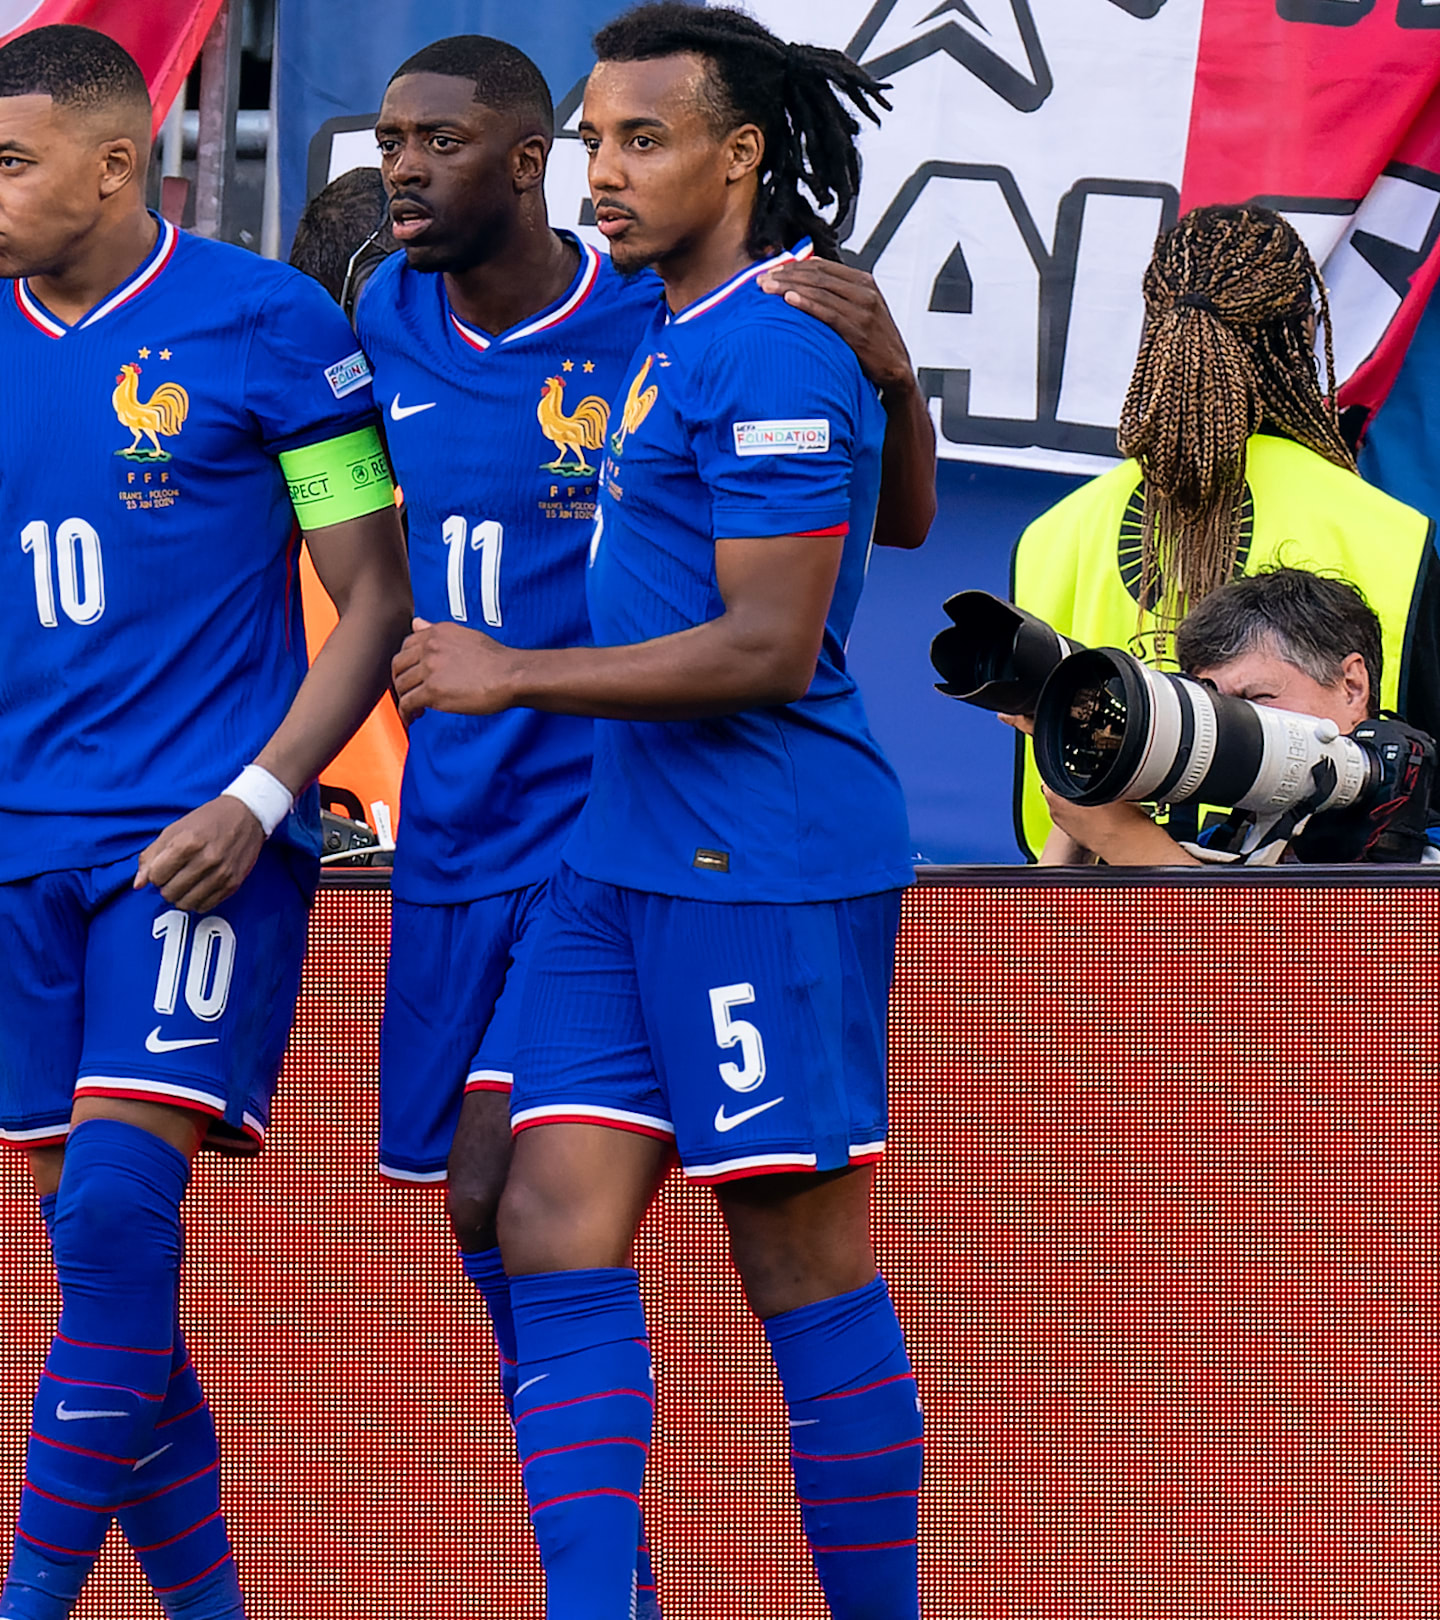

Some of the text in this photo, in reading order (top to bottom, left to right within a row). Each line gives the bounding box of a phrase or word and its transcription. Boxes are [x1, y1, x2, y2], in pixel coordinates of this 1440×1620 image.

[737, 430, 826, 443] FOUNDATION
[20, 517, 105, 628] 10
[442, 514, 503, 628] 11
[152, 909, 237, 1022] 10
[708, 982, 766, 1093] 5
